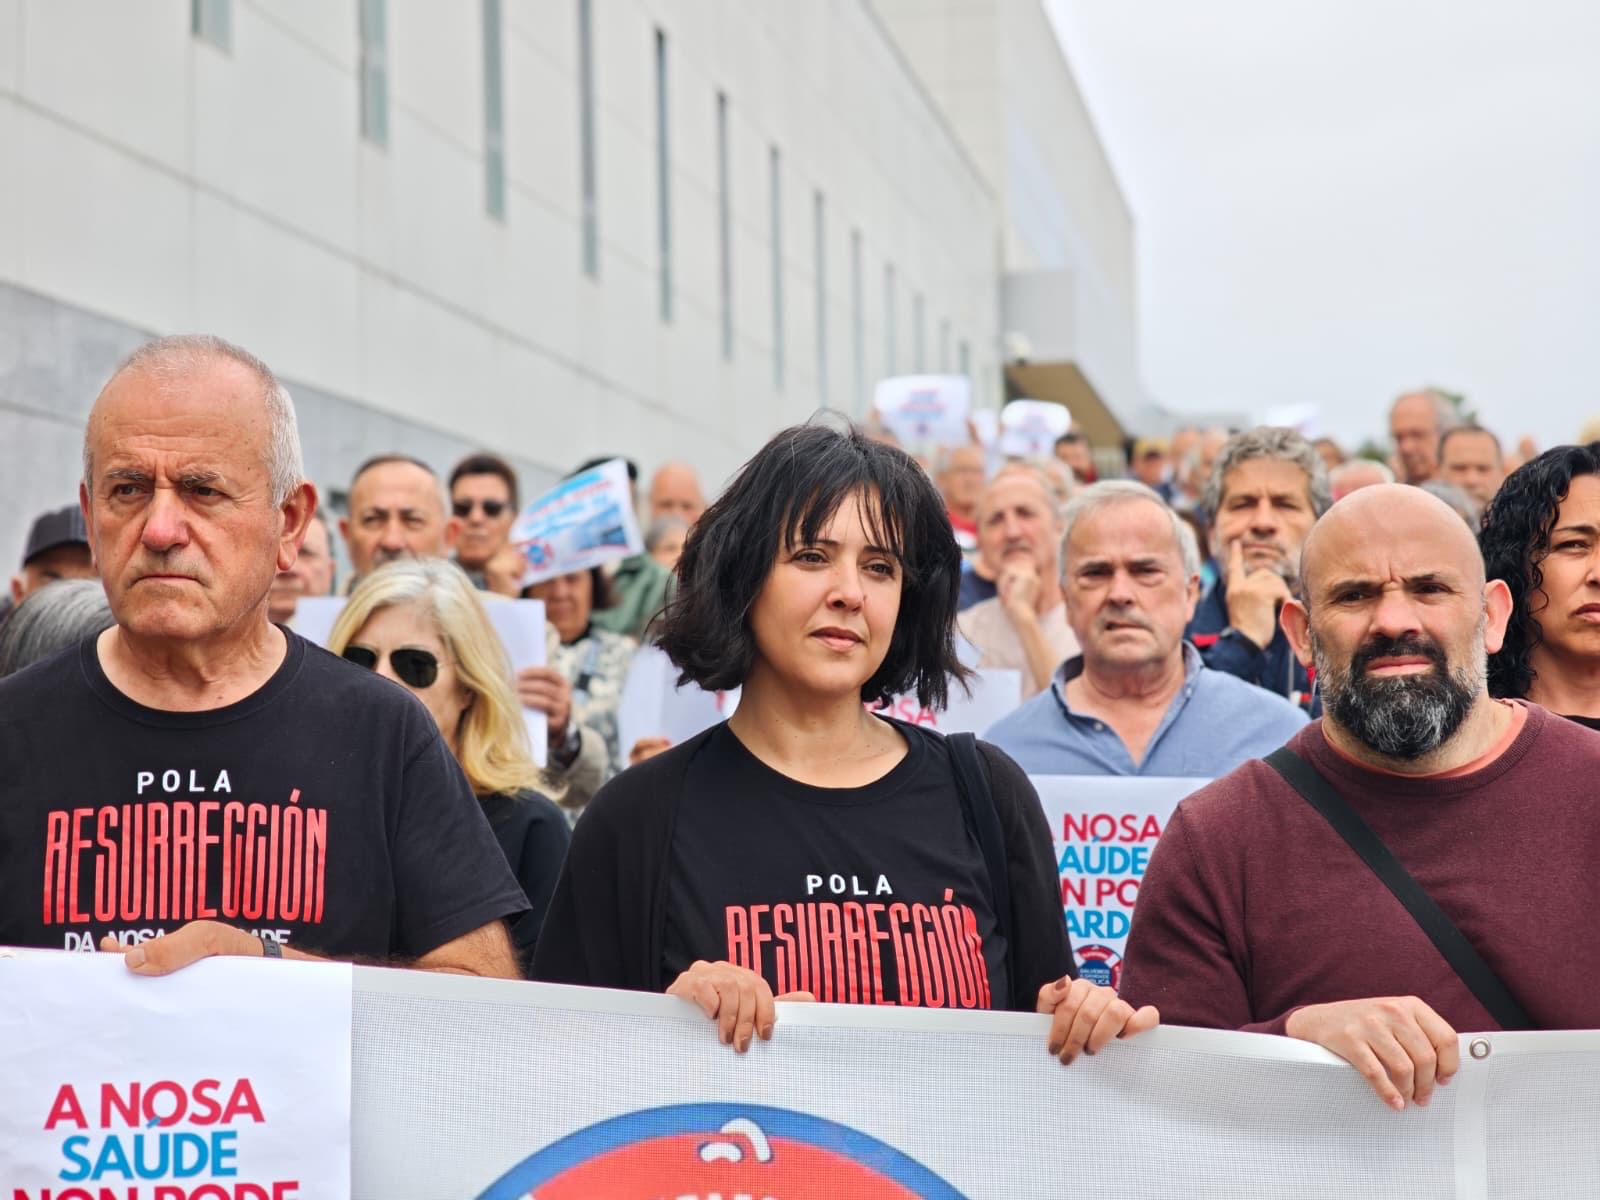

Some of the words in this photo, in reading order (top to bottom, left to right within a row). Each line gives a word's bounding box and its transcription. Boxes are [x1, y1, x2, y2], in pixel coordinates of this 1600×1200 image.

[136, 769, 232, 794] POLA
[1063, 813, 1162, 843] NOSA
[43, 788, 328, 925] RESURRECCIÓN
[1057, 836, 1149, 875] AÚDE
[806, 874, 893, 896] POLA
[1096, 878, 1141, 908] PO
[1064, 909, 1130, 939] ARD
[64, 931, 96, 952] DA
[43, 1084, 89, 1130] A
[100, 1078, 266, 1128] NOSA
[58, 1115, 238, 1182] SAÚDE
